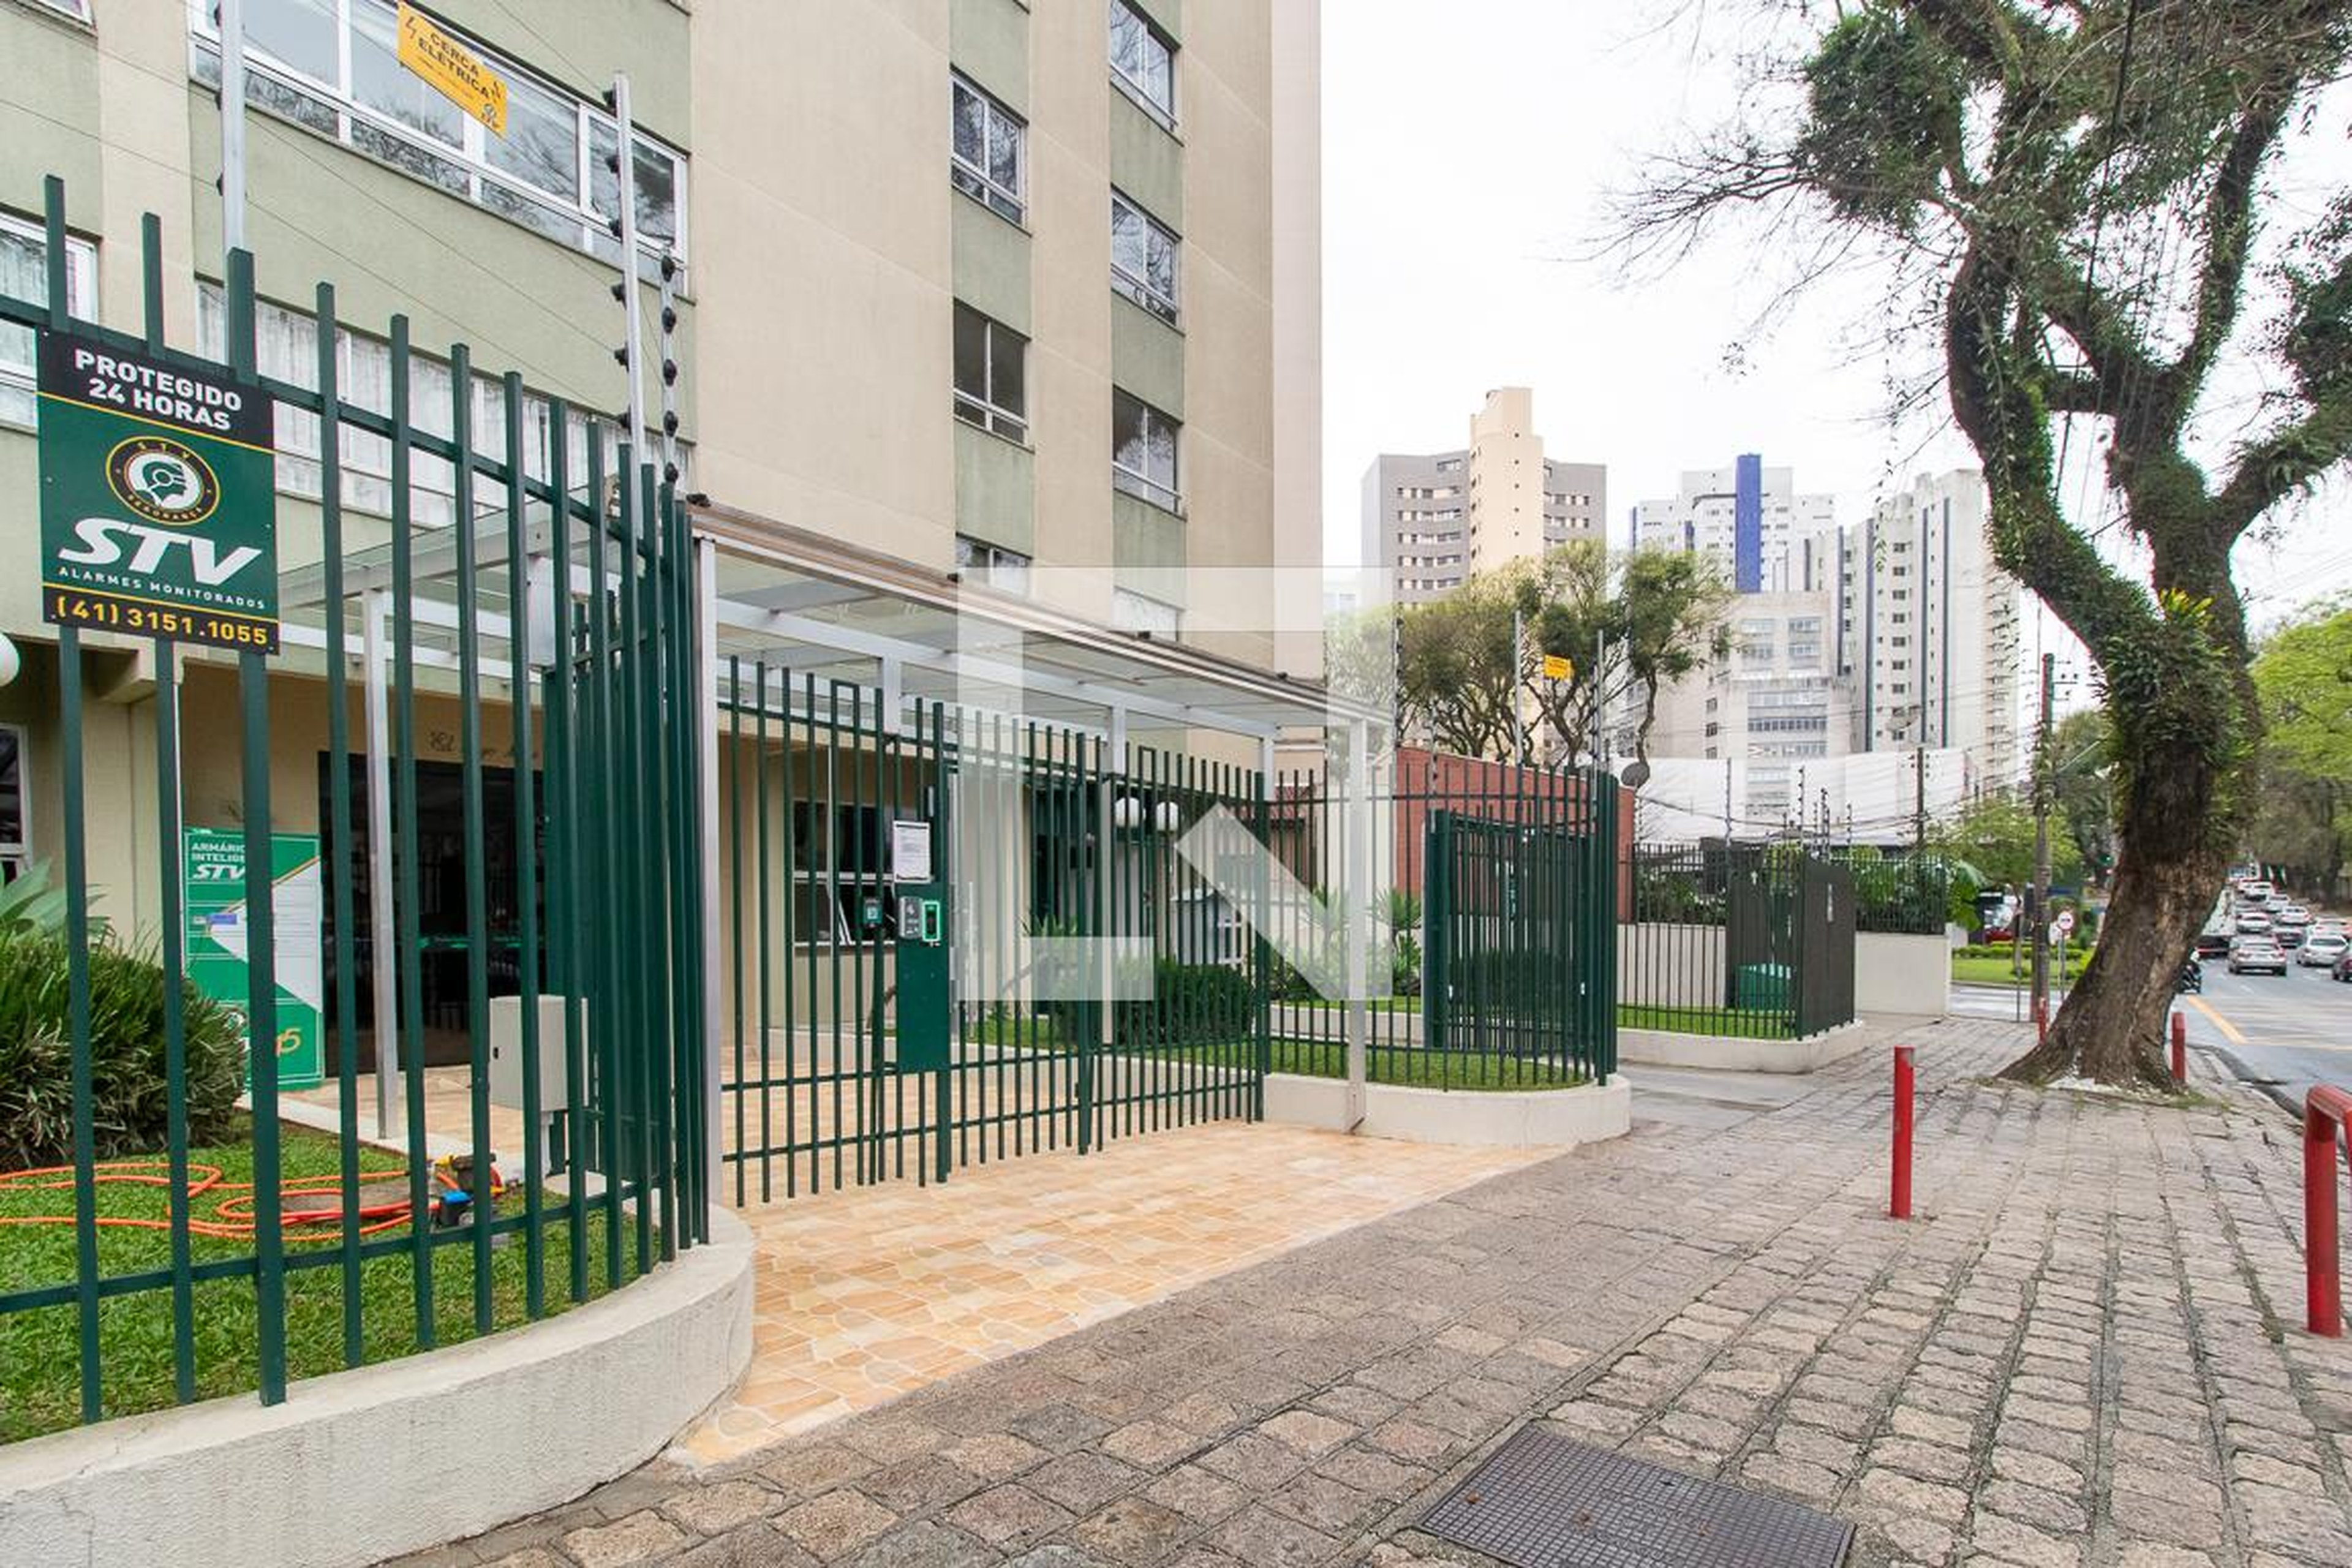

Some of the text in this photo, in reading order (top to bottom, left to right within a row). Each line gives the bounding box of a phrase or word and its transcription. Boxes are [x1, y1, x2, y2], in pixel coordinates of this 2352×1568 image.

[430, 32, 478, 77] CERCA
[74, 348, 242, 411] PROTEGIDO
[89, 377, 232, 431] 24 HORAS
[58, 518, 263, 586] STV
[59, 567, 265, 609] ALARMES MONITORADOS
[58, 595, 268, 645] (41) 3151.1055
[193, 862, 245, 880] STV
